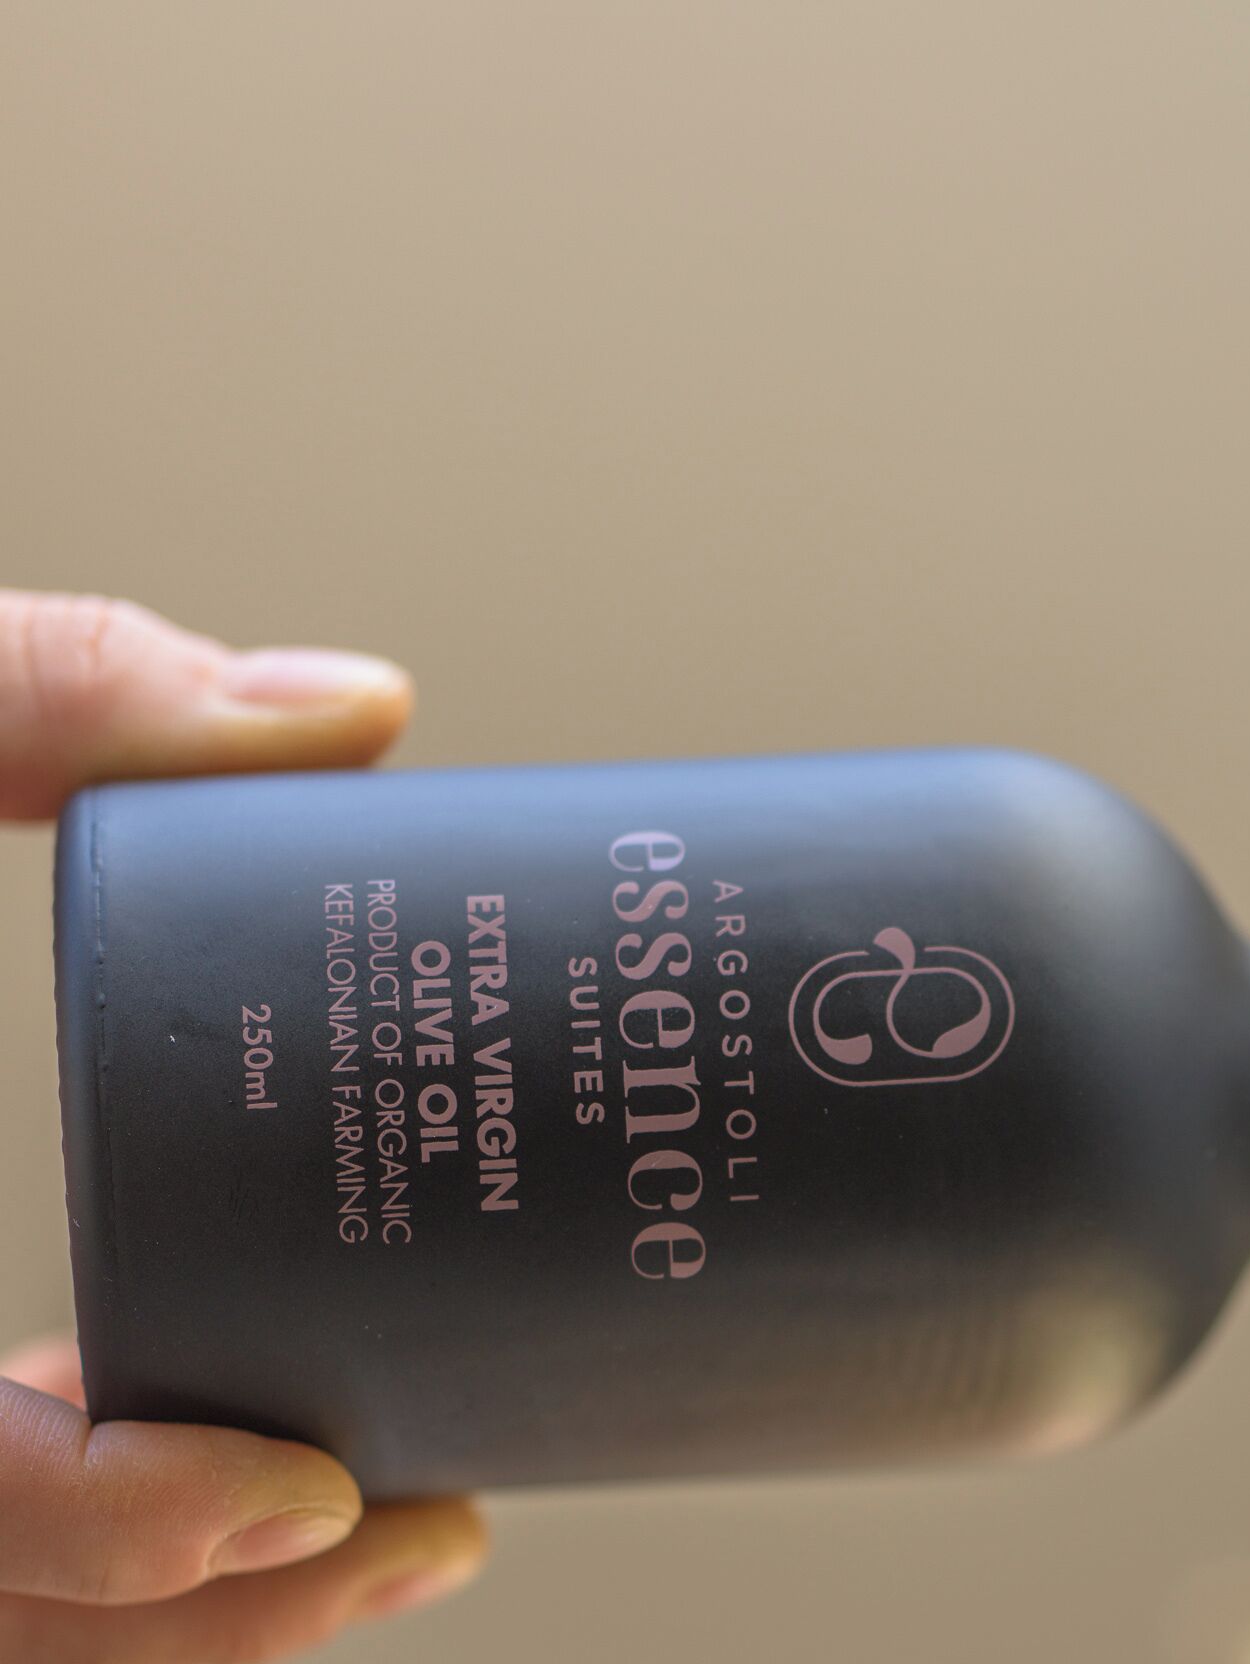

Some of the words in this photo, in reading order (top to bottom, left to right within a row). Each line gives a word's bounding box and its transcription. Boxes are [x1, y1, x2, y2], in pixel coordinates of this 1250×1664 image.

[325, 884, 360, 1072] KEFALONIAN
[367, 879, 401, 1012] PRODUCT
[411, 940, 454, 1067] OLIVE
[467, 895, 509, 1026] EXTRA
[241, 1004, 277, 1110] 250ml
[371, 1021, 404, 1066] OF
[568, 957, 605, 1125] SUITES
[610, 831, 706, 1280] essence
[713, 880, 760, 1202] ARGOSTOLI
[332, 1084, 368, 1244] FARMING
[374, 1078, 412, 1245] ORGANIC
[418, 1084, 459, 1163] OIL
[473, 1038, 519, 1211] VIRGIN
